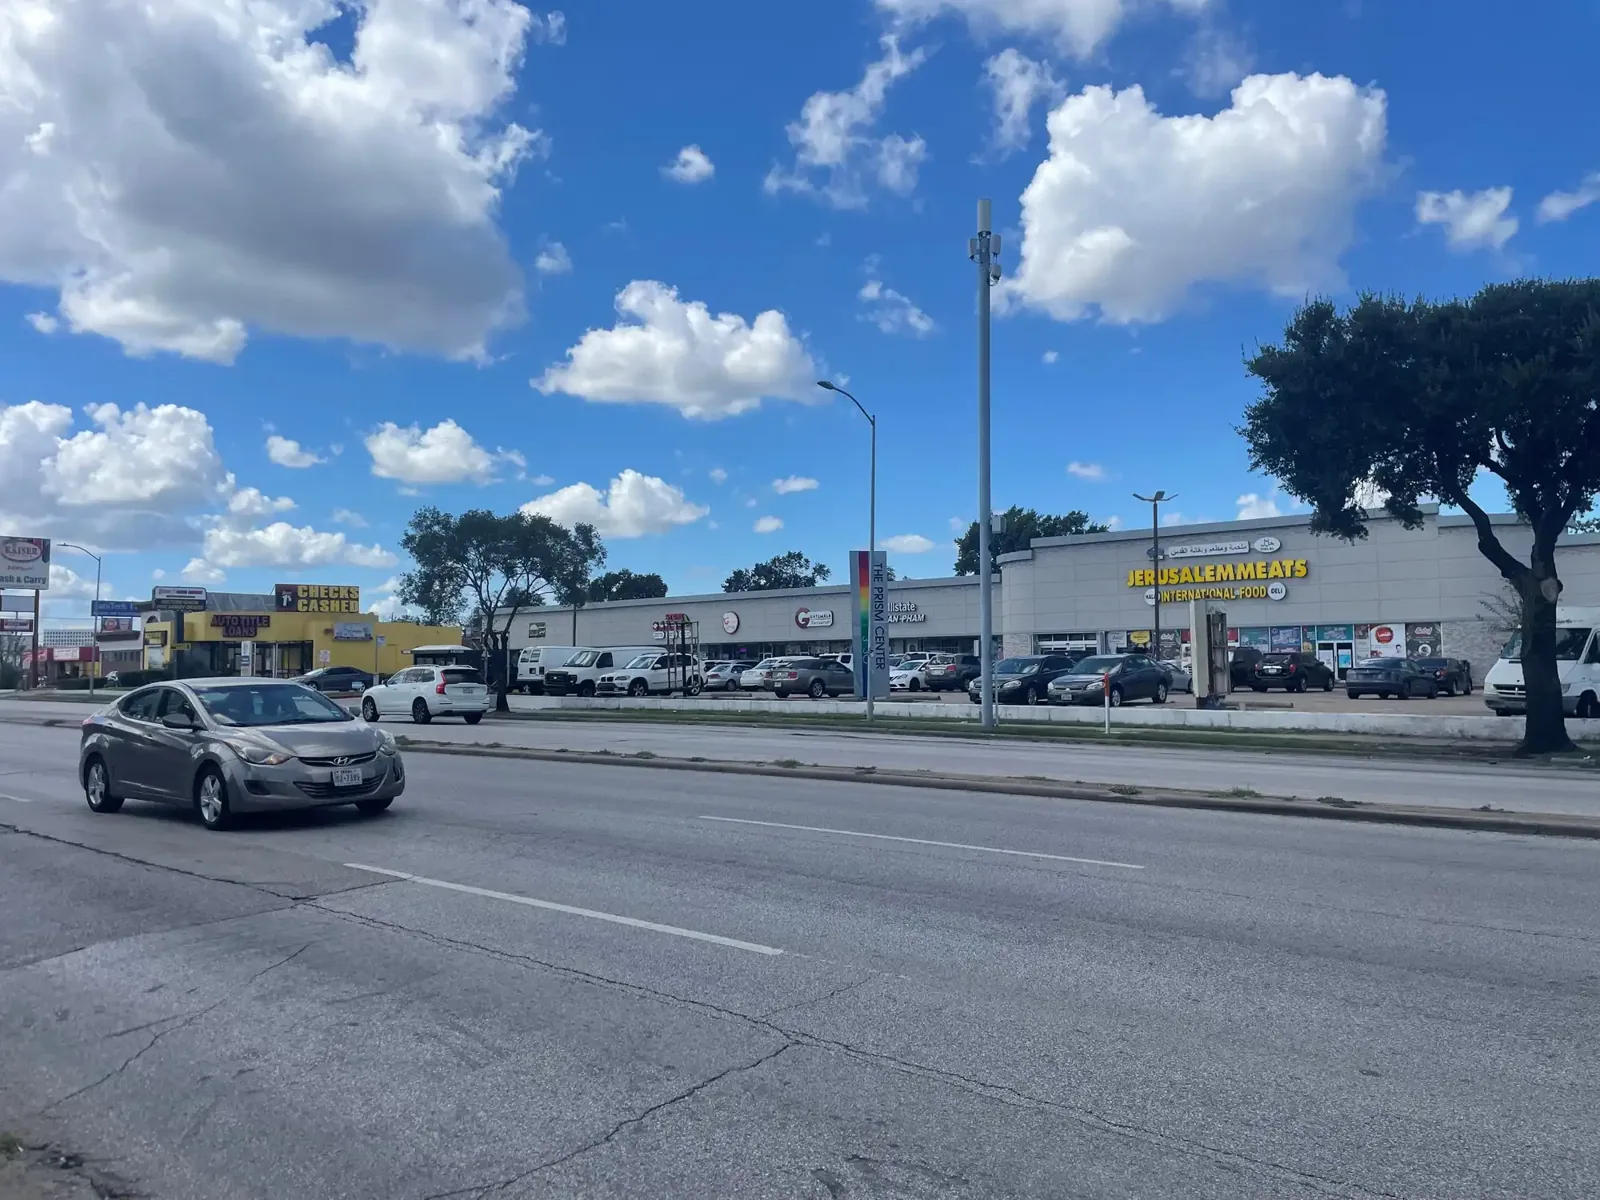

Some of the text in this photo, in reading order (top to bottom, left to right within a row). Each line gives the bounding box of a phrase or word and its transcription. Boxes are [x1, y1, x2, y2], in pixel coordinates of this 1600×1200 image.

[0, 575, 15, 584] ash
[23, 575, 47, 585] Carry
[297, 585, 359, 599] CHECKS
[1239, 585, 1267, 599] FOOD
[297, 599, 359, 612] CASHED
[887, 601, 916, 612] llstate
[211, 615, 269, 626] AUTO TITLE
[873, 563, 886, 670] THE PRISM CENTER
[887, 614, 925, 623] AN-PHAM
[223, 626, 256, 636] LOANS
